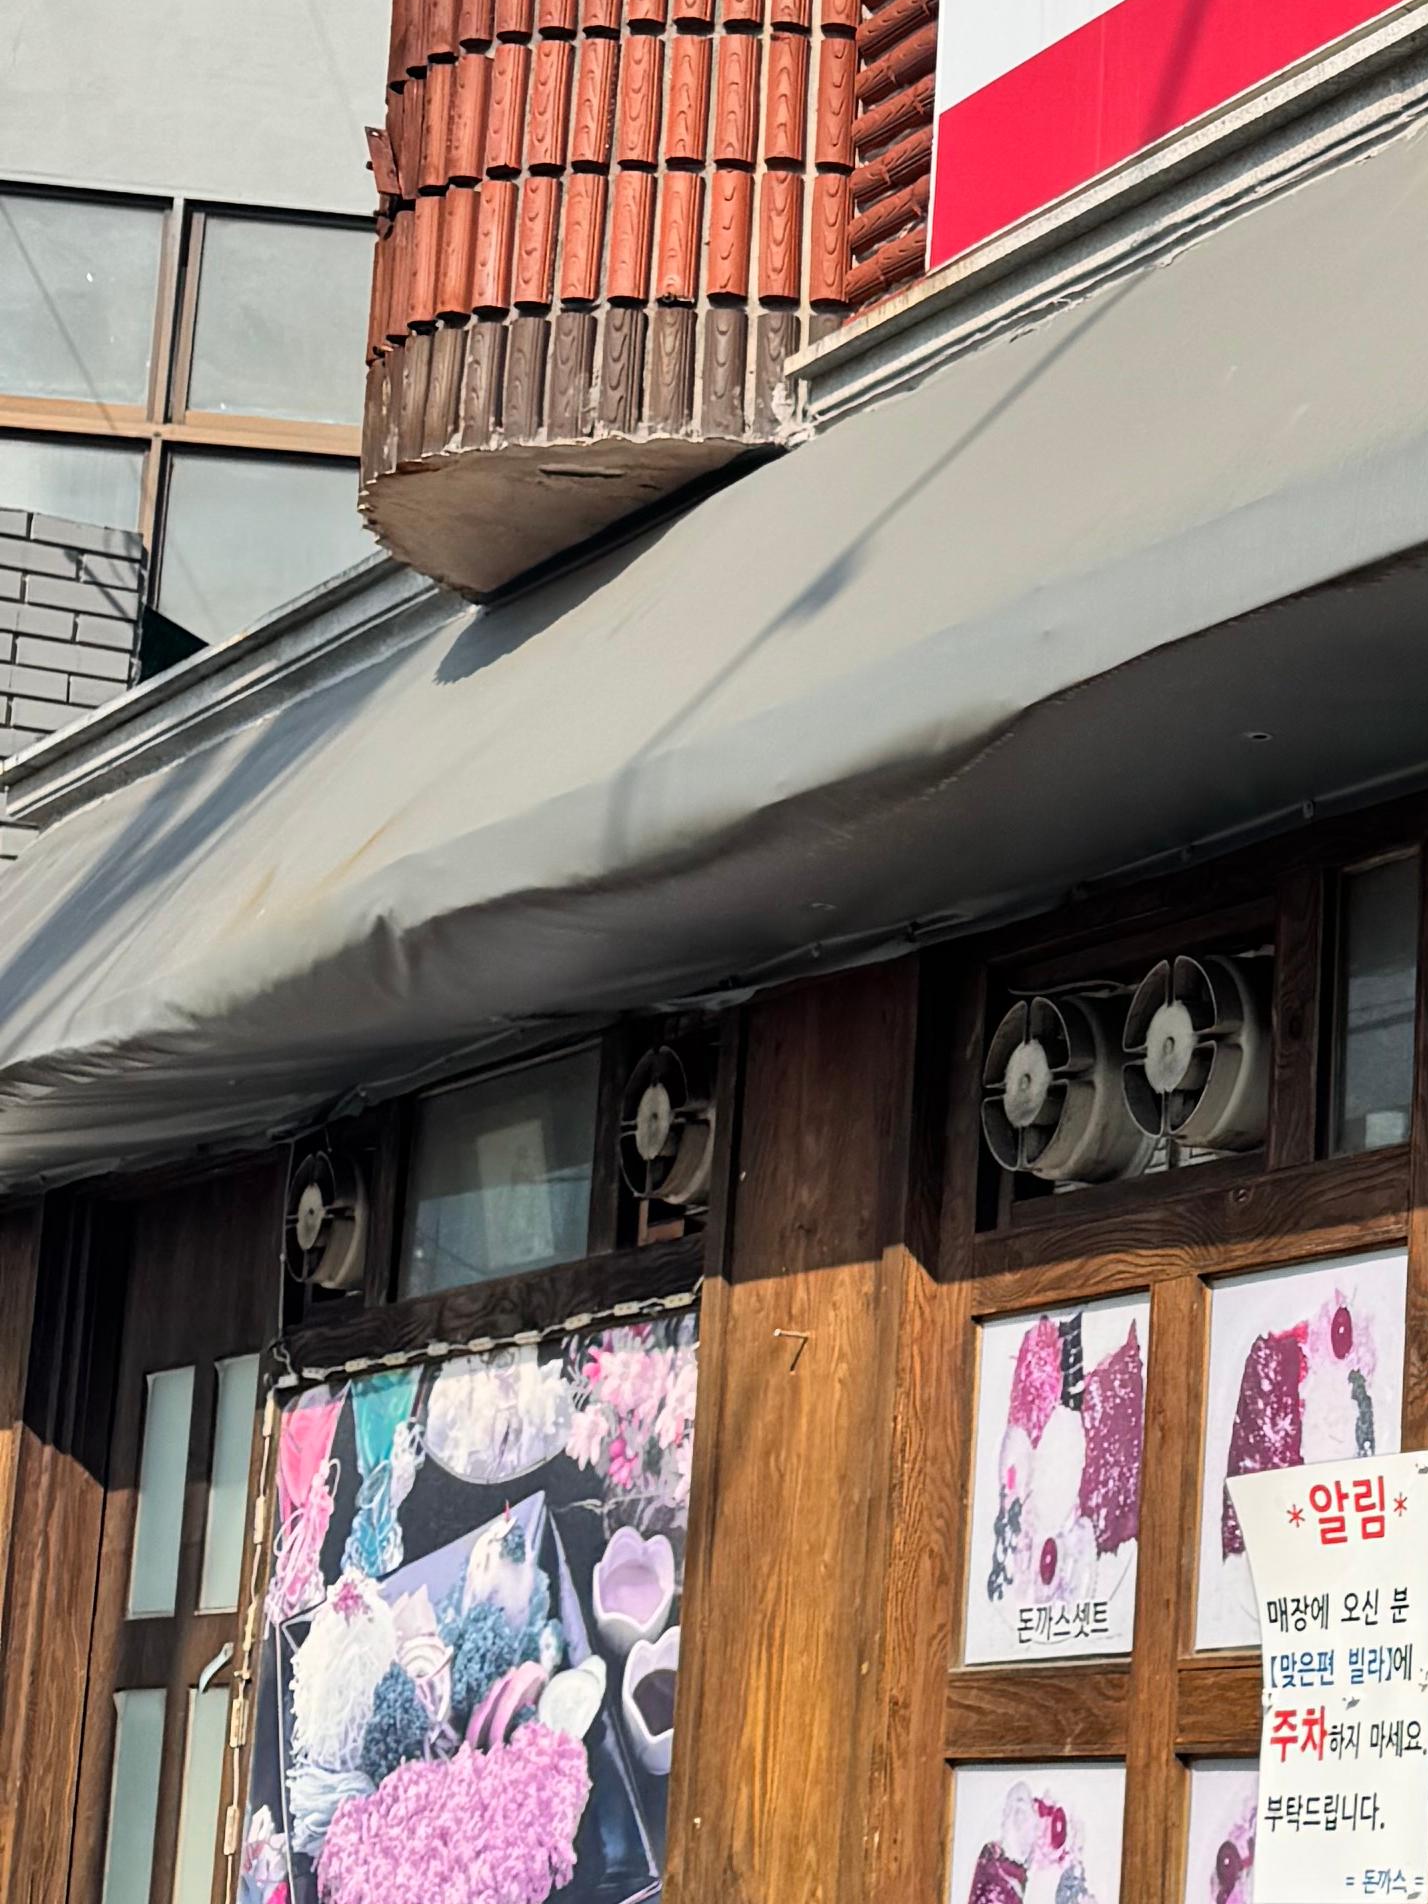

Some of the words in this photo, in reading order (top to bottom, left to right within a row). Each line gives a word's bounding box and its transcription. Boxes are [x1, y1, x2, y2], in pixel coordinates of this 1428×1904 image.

[1309, 1474, 1387, 1546] 알림
[1017, 1601, 1109, 1644] 돈까스셋트
[1267, 1593, 1330, 1633] 매장에
[1341, 1588, 1379, 1626] 오신
[1390, 1587, 1410, 1624] 분
[1269, 1705, 1361, 1763] 주차하지
[1370, 1719, 1428, 1759] 마세요.
[1264, 1791, 1387, 1834] 부탁드립니다.
